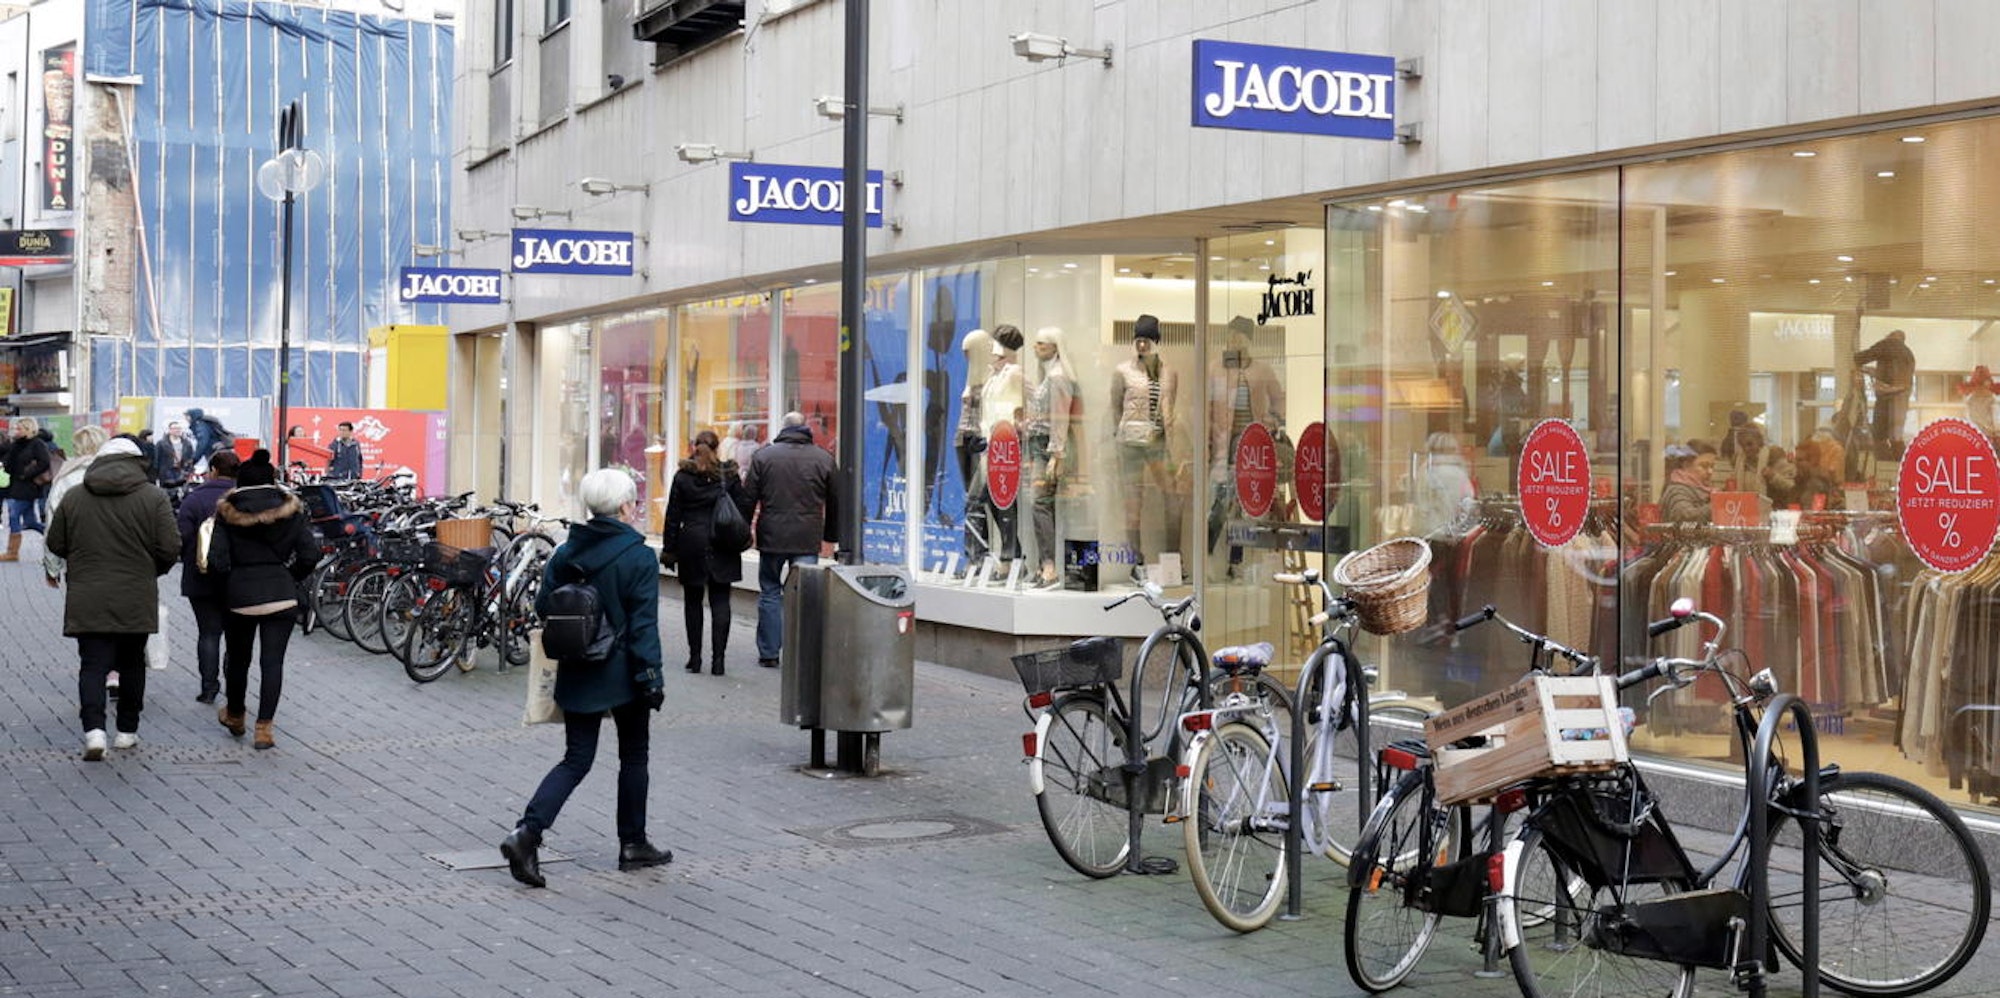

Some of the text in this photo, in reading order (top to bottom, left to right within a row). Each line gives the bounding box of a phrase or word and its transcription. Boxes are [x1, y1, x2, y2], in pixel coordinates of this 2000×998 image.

[1205, 60, 1393, 119] JACOBI
[51, 141, 66, 205] DUNIA
[19, 236, 51, 248] DUNIA
[513, 237, 632, 269] JACOBI
[402, 273, 500, 299] JACOBI
[1257, 289, 1315, 326] JACOBI
[992, 441, 1016, 464] SALE
[1917, 428, 1982, 450] TOLLE ANGEBOTE
[1241, 445, 1271, 470] SALE
[1302, 446, 1324, 471] SAL
[1530, 450, 1578, 483] SALE
[1915, 456, 1984, 495] SALE
[1545, 497, 1562, 527] %
[1906, 498, 1995, 509] JETZT REDUZIERT
[1938, 512, 1961, 548] %
